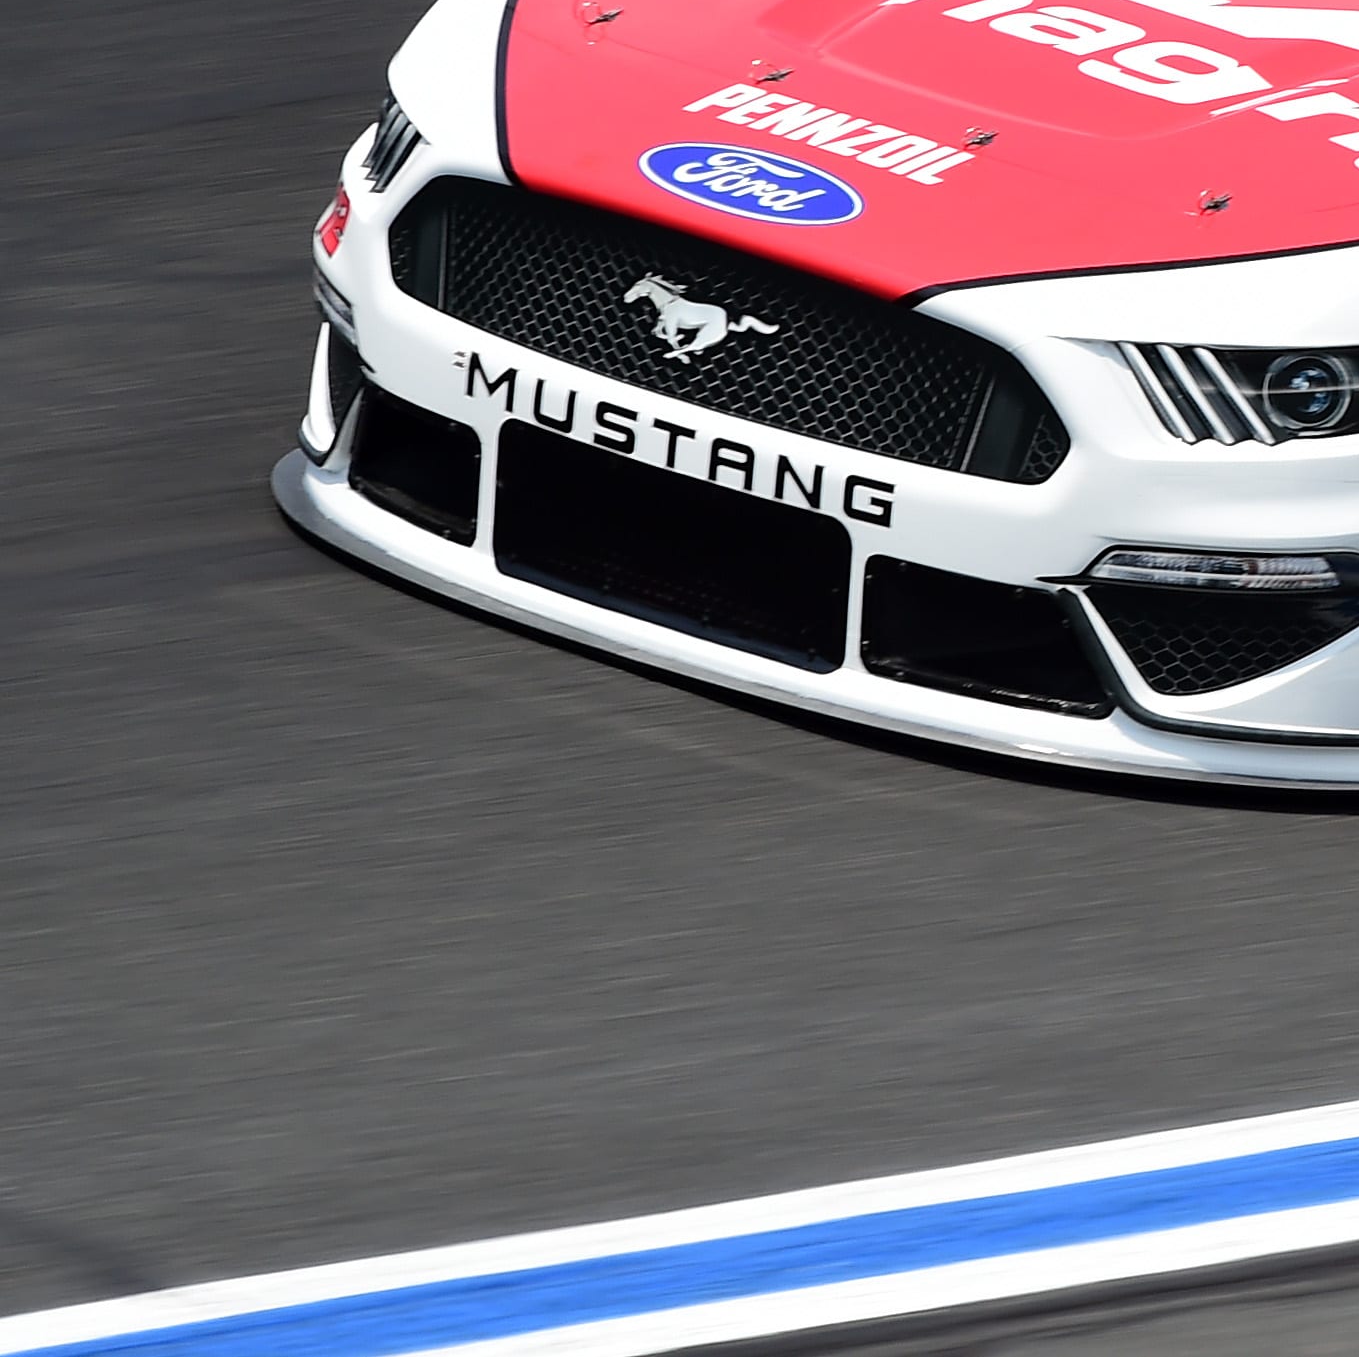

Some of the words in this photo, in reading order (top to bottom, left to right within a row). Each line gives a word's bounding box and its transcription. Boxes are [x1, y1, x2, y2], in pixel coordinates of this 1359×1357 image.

[673, 141, 828, 215] Ford
[683, 84, 975, 185] PENNZOIL
[467, 351, 897, 527] MUSTANG
